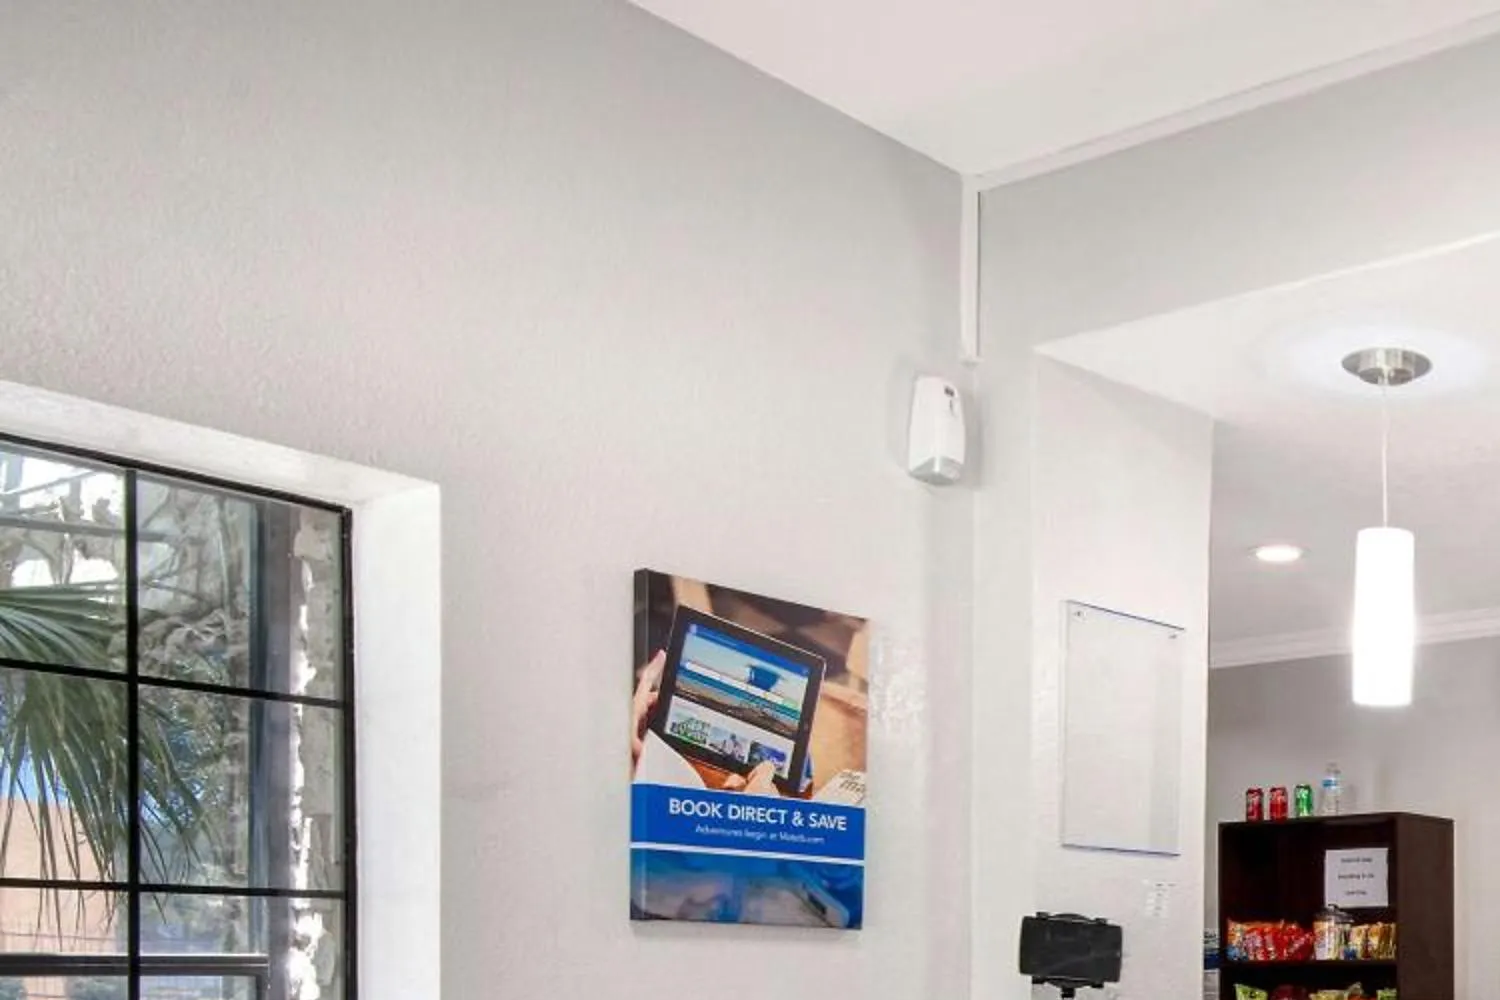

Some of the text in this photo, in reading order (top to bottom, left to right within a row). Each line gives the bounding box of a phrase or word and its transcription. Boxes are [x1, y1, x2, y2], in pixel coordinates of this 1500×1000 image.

[669, 797, 848, 831] BOOK DIRECT & SAVE
